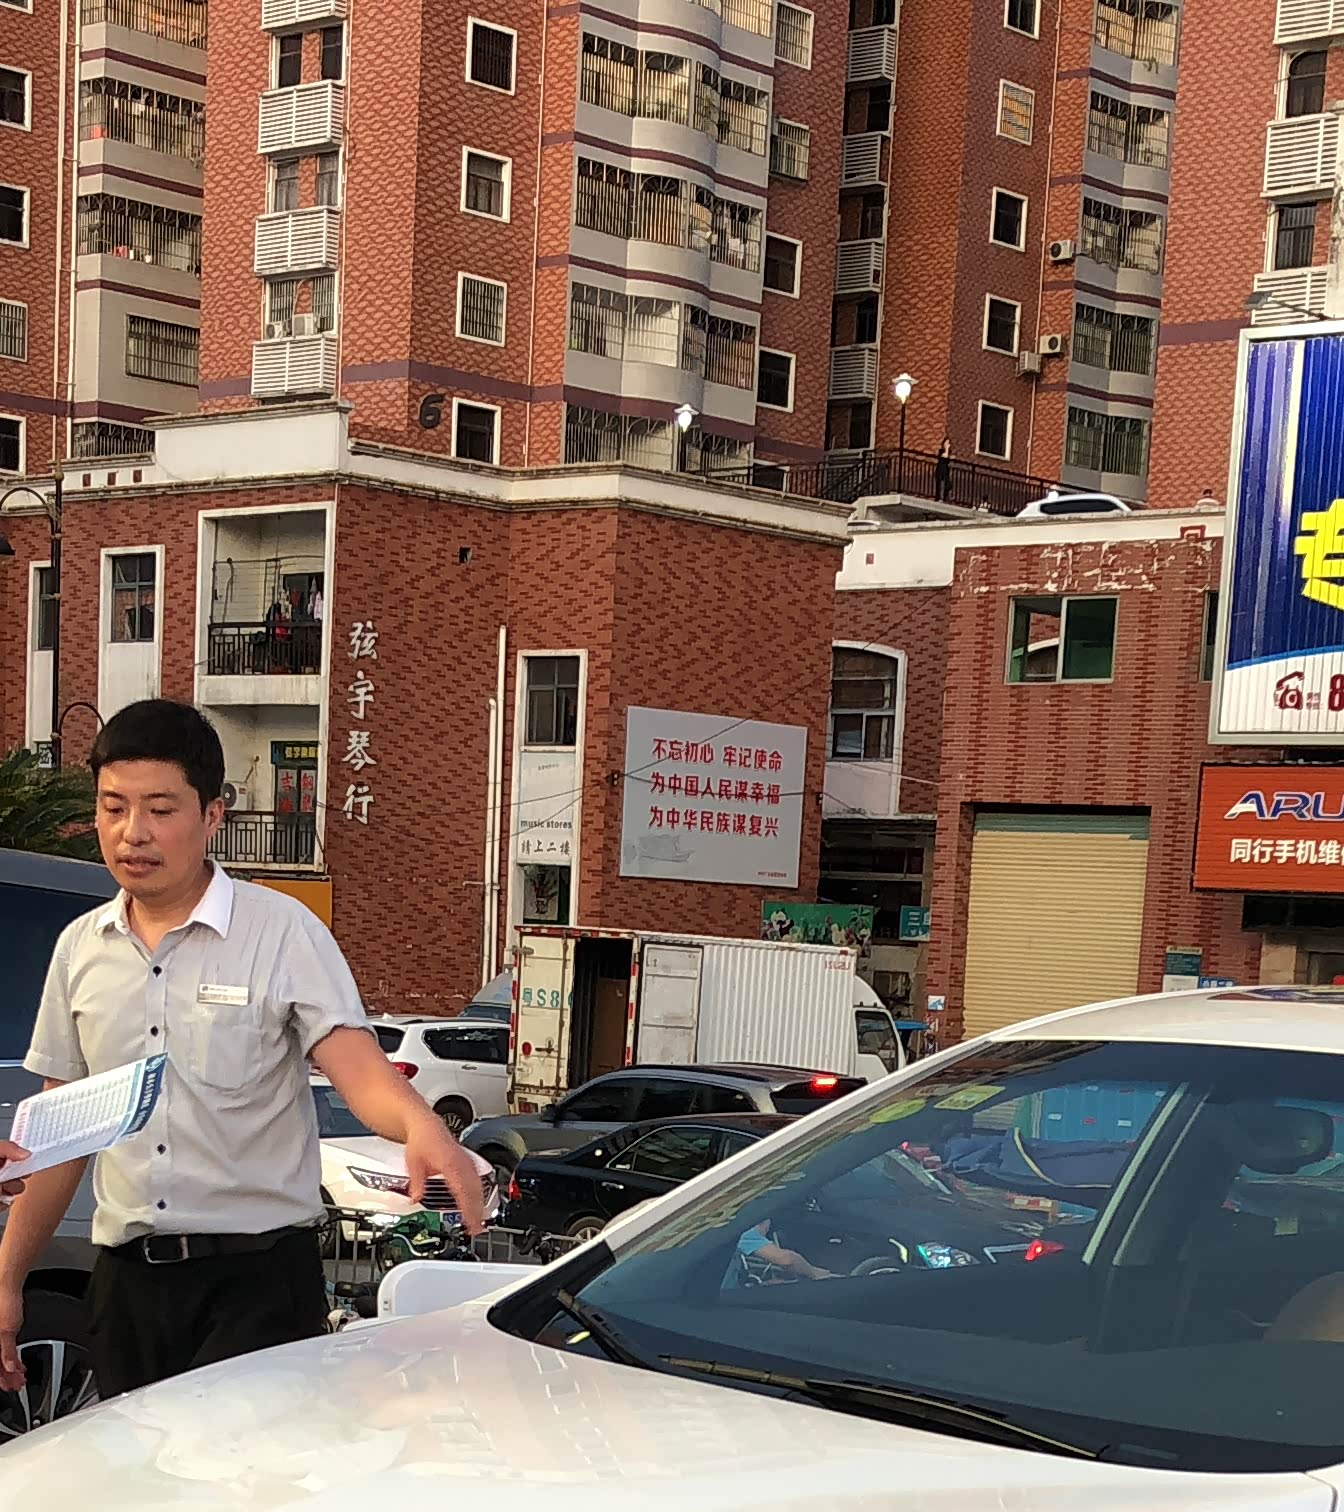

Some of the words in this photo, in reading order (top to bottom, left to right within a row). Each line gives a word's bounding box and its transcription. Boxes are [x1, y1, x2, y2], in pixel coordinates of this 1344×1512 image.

[419, 393, 444, 429] 6
[342, 620, 379, 826] 弦宇琴行
[652, 738, 715, 763] 不忘初心
[723, 745, 783, 773] 牢记使命
[650, 771, 781, 805] 为中国人民谋幸福
[648, 806, 779, 838] 为中华民族谋复兴
